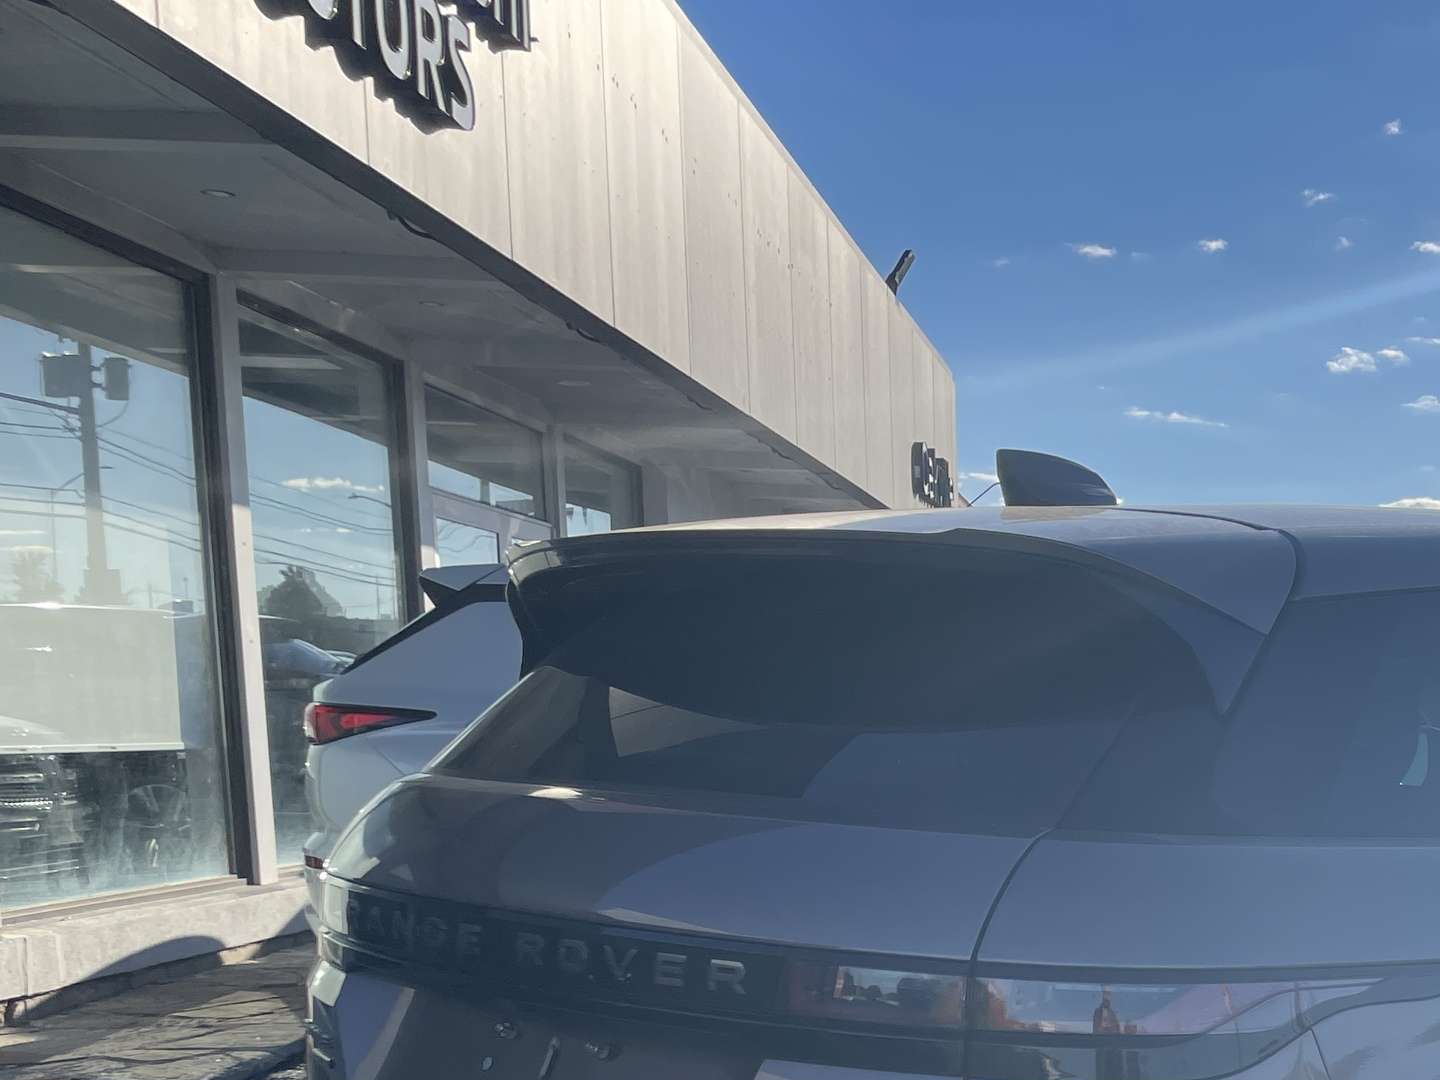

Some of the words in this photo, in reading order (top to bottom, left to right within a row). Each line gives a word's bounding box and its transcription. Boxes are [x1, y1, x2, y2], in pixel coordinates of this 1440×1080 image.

[308, 0, 476, 131] TORS
[348, 898, 483, 958] RANGE
[514, 931, 748, 996] ROVER
